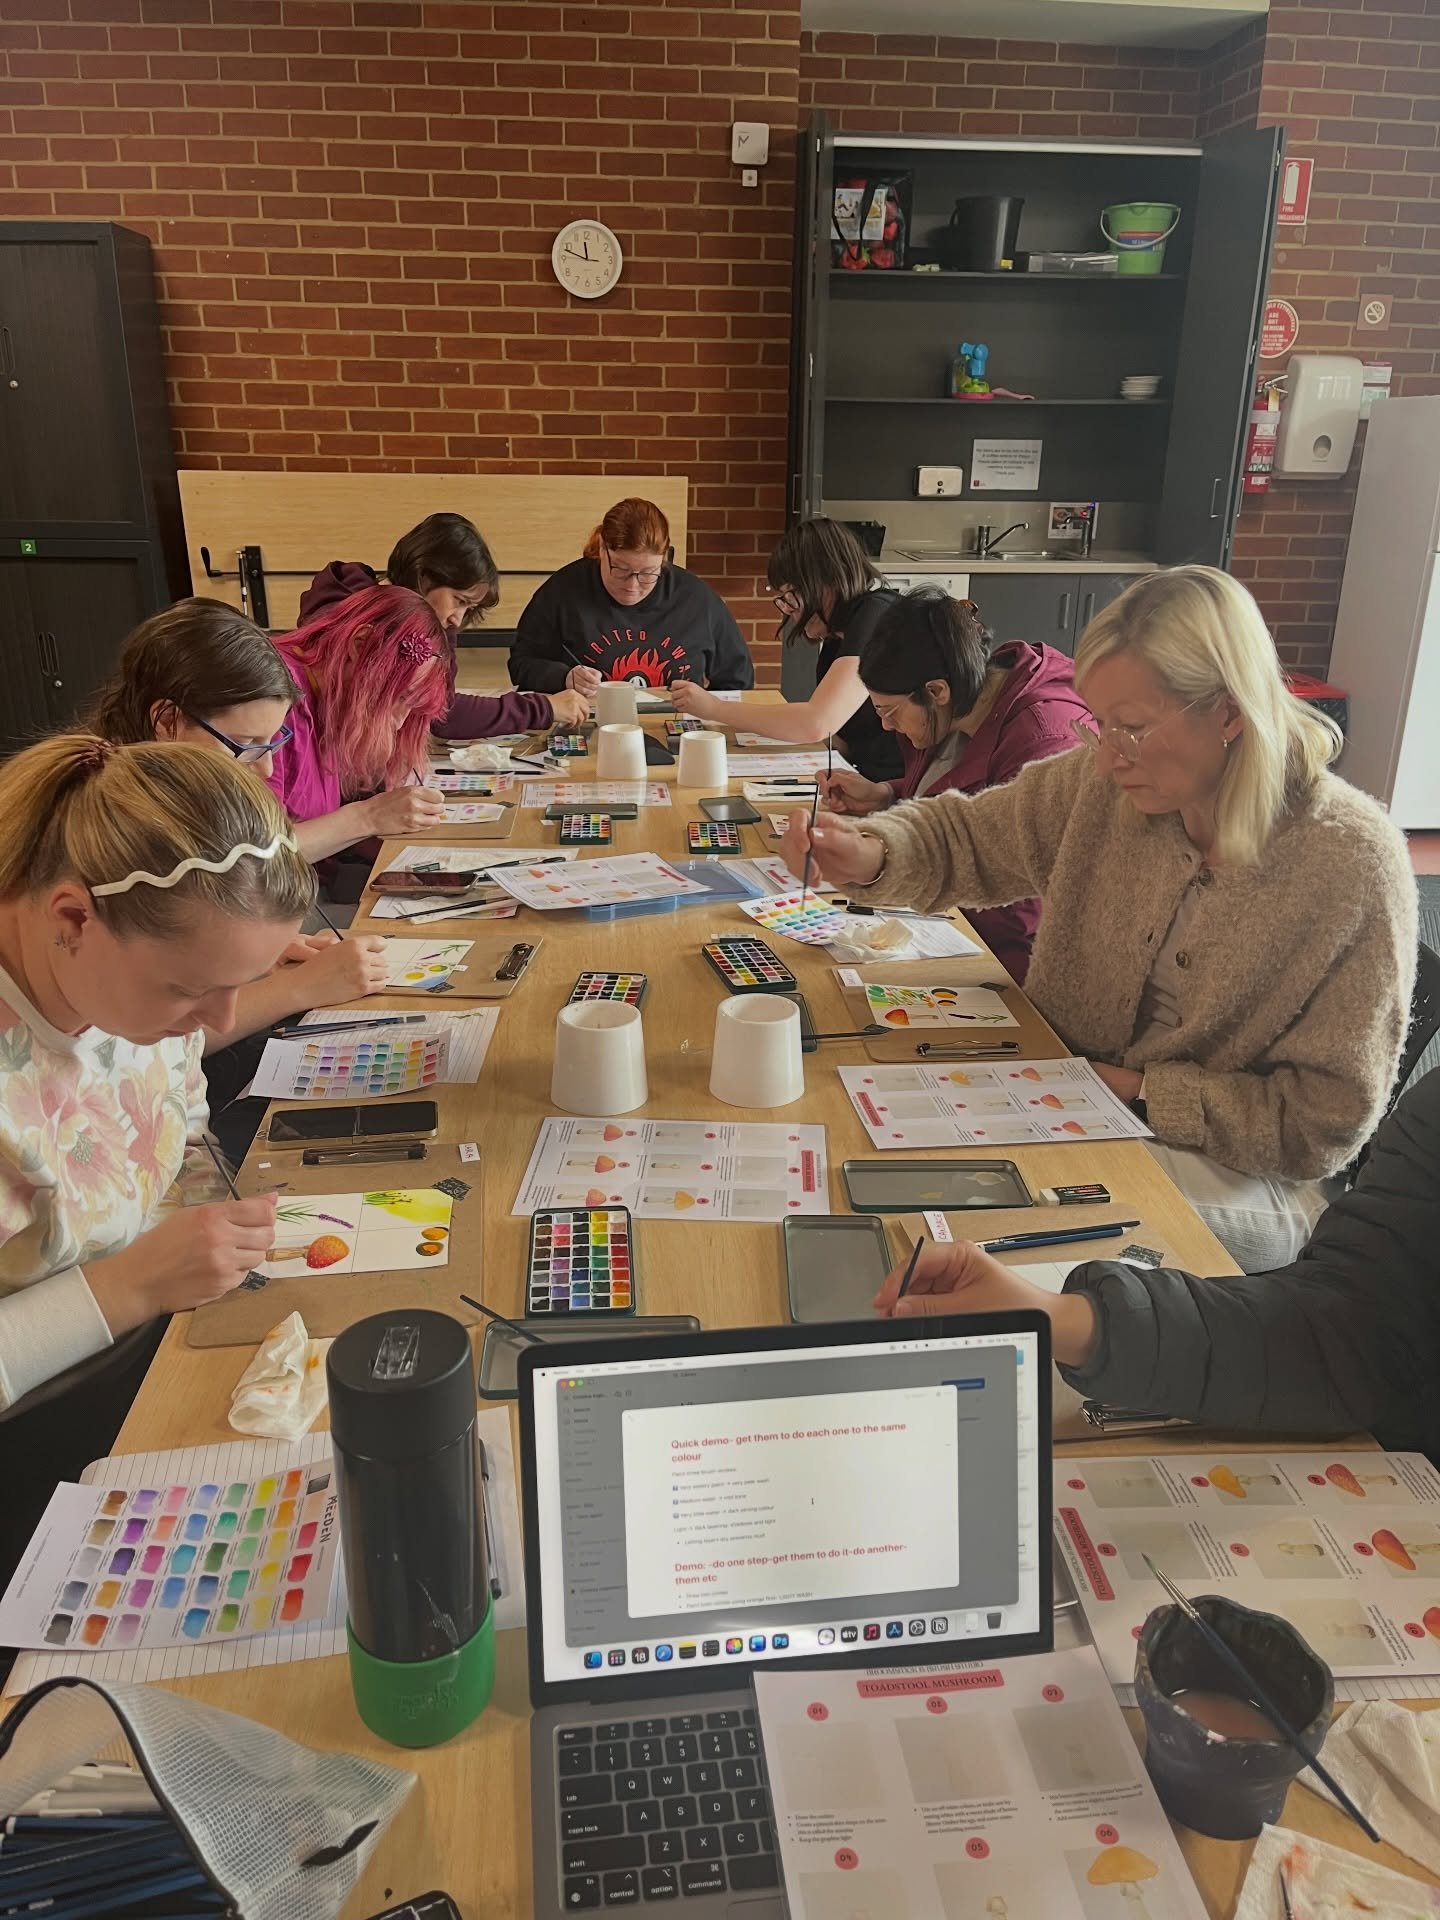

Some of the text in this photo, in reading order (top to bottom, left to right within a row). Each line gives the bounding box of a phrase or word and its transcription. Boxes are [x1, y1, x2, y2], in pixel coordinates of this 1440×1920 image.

[25, 544, 32, 552] 2
[672, 1439, 699, 1449] Quick
[702, 1438, 733, 1446] demo-
[736, 1436, 752, 1445] get
[754, 1433, 778, 1441] them
[792, 1430, 804, 1438] do
[806, 1428, 830, 1438] each
[672, 1453, 702, 1462] colour
[320, 1495, 338, 1543] MEEDEN
[675, 1562, 705, 1572] Demo:
[790, 1552, 815, 1560] them
[828, 1549, 840, 1558] do
[676, 1574, 718, 1584] them etc
[635, 1653, 646, 1664] 18
[864, 1675, 998, 1692] TOADSTOOL MUSHROOM
[680, 1748, 686, 1757] 3
[714, 1744, 720, 1752] 4
[644, 1752, 650, 1760] 2
[700, 1772, 708, 1782] E
[736, 1768, 743, 1777] R
[628, 1780, 636, 1790] Q
[662, 1776, 673, 1785] W
[713, 1802, 720, 1812] D
[750, 1800, 756, 1808] F
[640, 1811, 648, 1820] A
[677, 1807, 684, 1816] S
[738, 1834, 744, 1842] C
[1101, 1830, 1112, 1838] 06
[664, 1842, 670, 1851] Z
[700, 1838, 708, 1846] X
[972, 1844, 983, 1852] 05
[570, 1860, 585, 1868] shift
[688, 1879, 722, 1889] command
[651, 1884, 673, 1894] option
[610, 1889, 634, 1899] control
